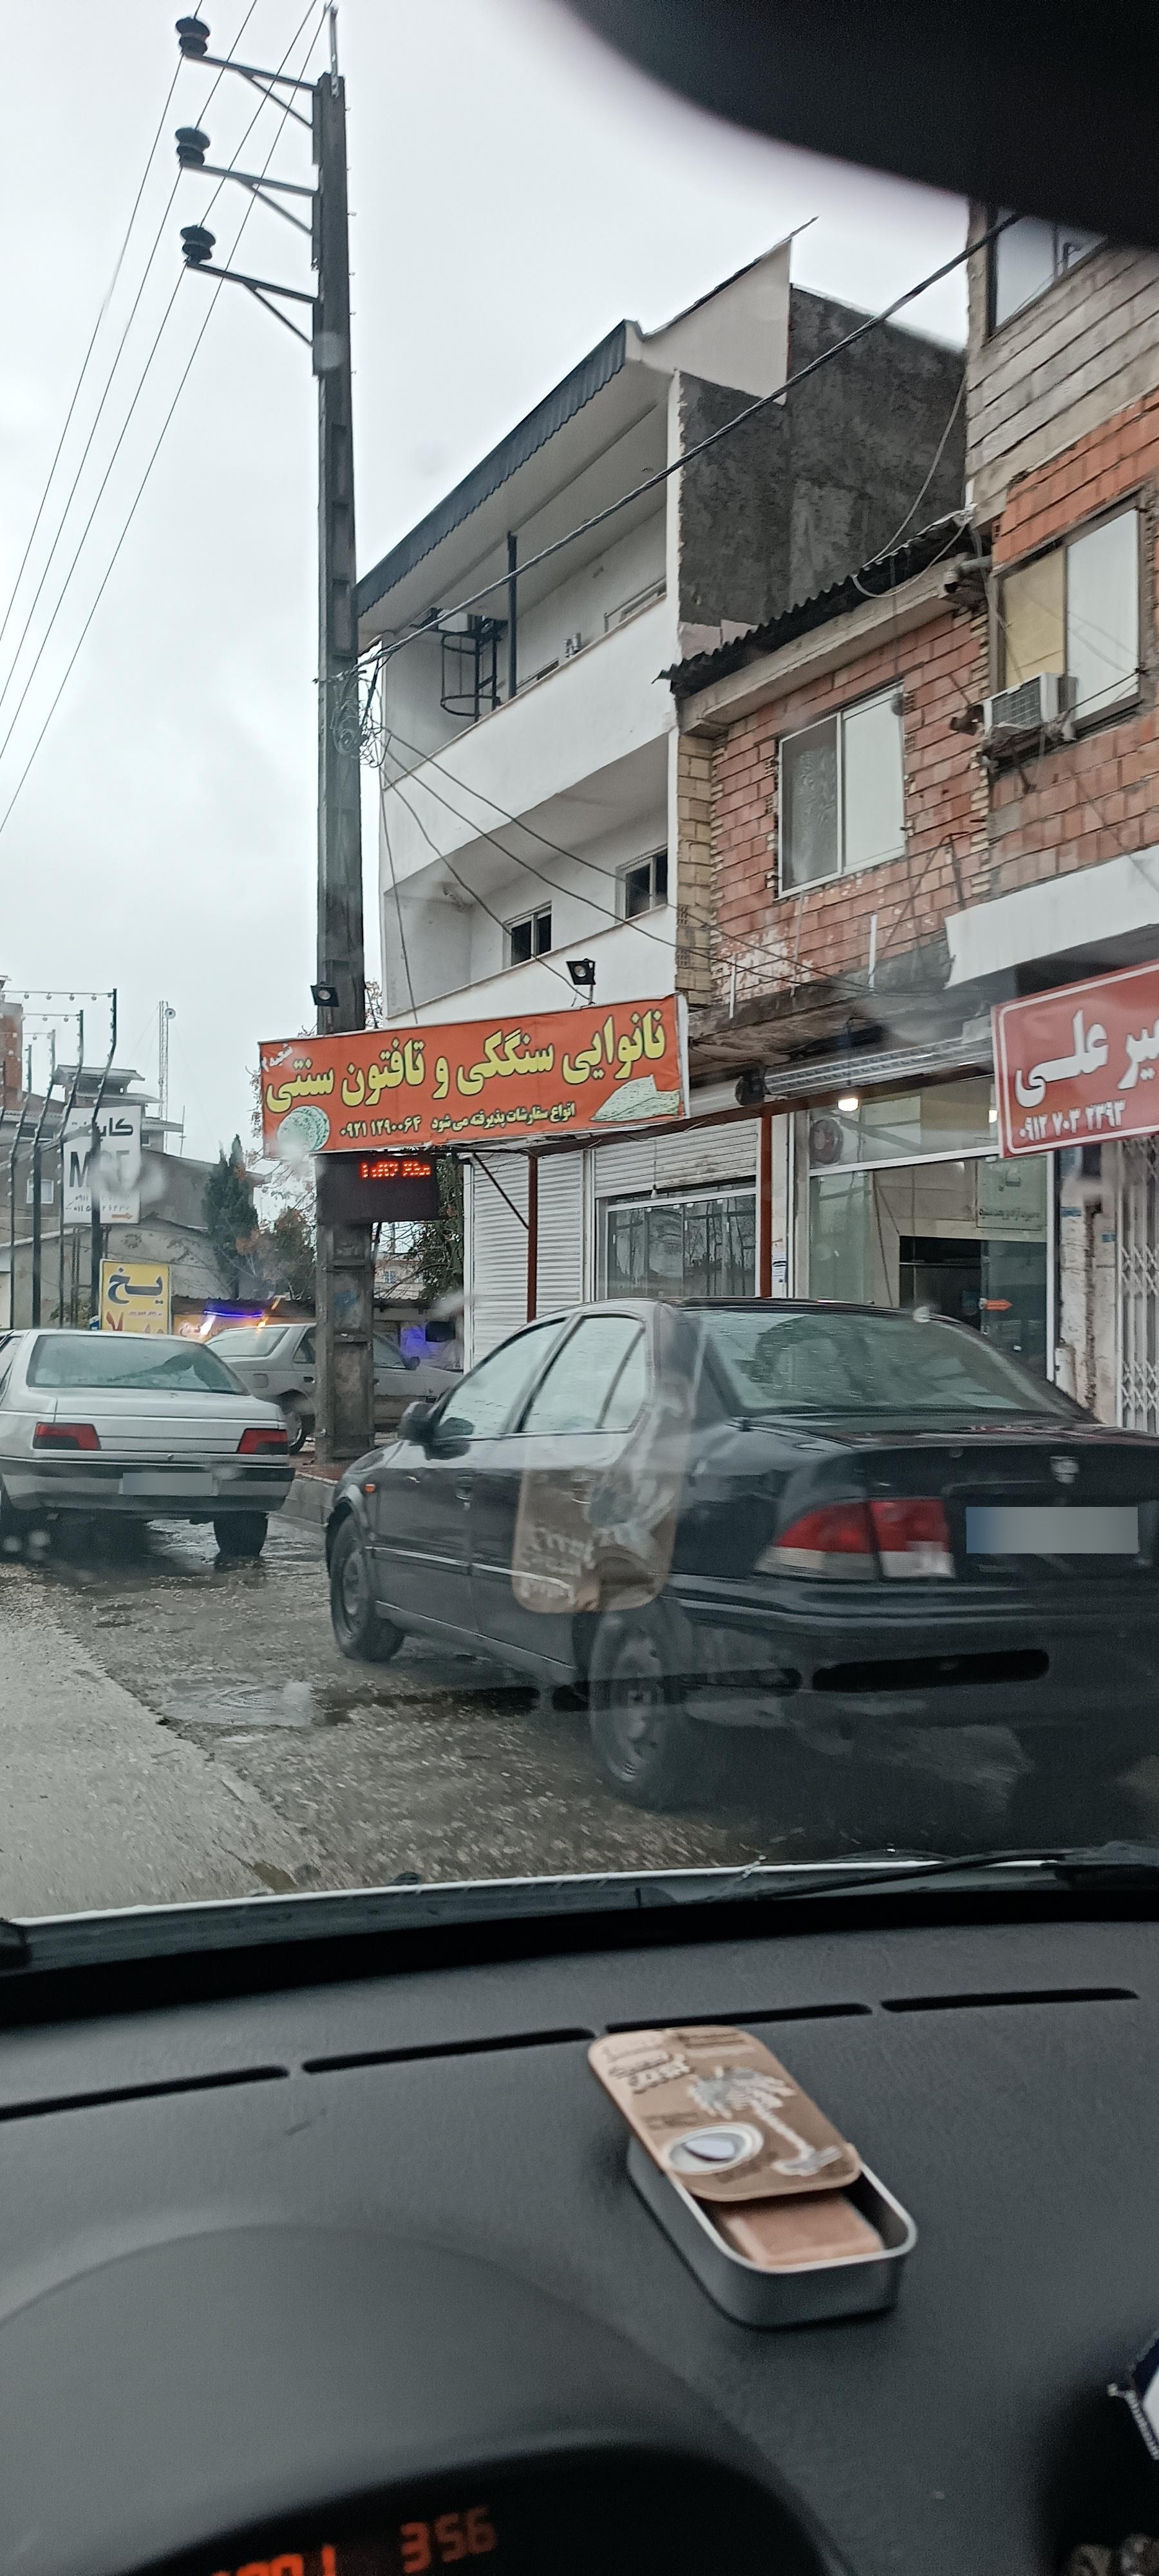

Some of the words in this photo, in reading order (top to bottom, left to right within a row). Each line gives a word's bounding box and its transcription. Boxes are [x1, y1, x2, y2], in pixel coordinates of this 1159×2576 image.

[456, 1028, 555, 1096] سنگکی
[562, 1009, 666, 1084] نانوایی
[1015, 1009, 1109, 1108] علی
[1117, 1018, 1159, 1090] یر
[265, 1058, 335, 1113] سنتی
[341, 1037, 426, 1107] تافتون
[432, 1056, 450, 1099] و
[431, 1113, 451, 1133] شود
[451, 1117, 469, 1132] می
[469, 1108, 505, 1130] پذیرفته
[506, 1105, 548, 1125] سفارشات
[550, 1102, 576, 1122] انواع
[1019, 1114, 1048, 1141] ۰۹۱۲
[1051, 1108, 1080, 1137] ۷۰۳
[70, 1150, 130, 1188] MF
[108, 1267, 164, 1305] یخ
